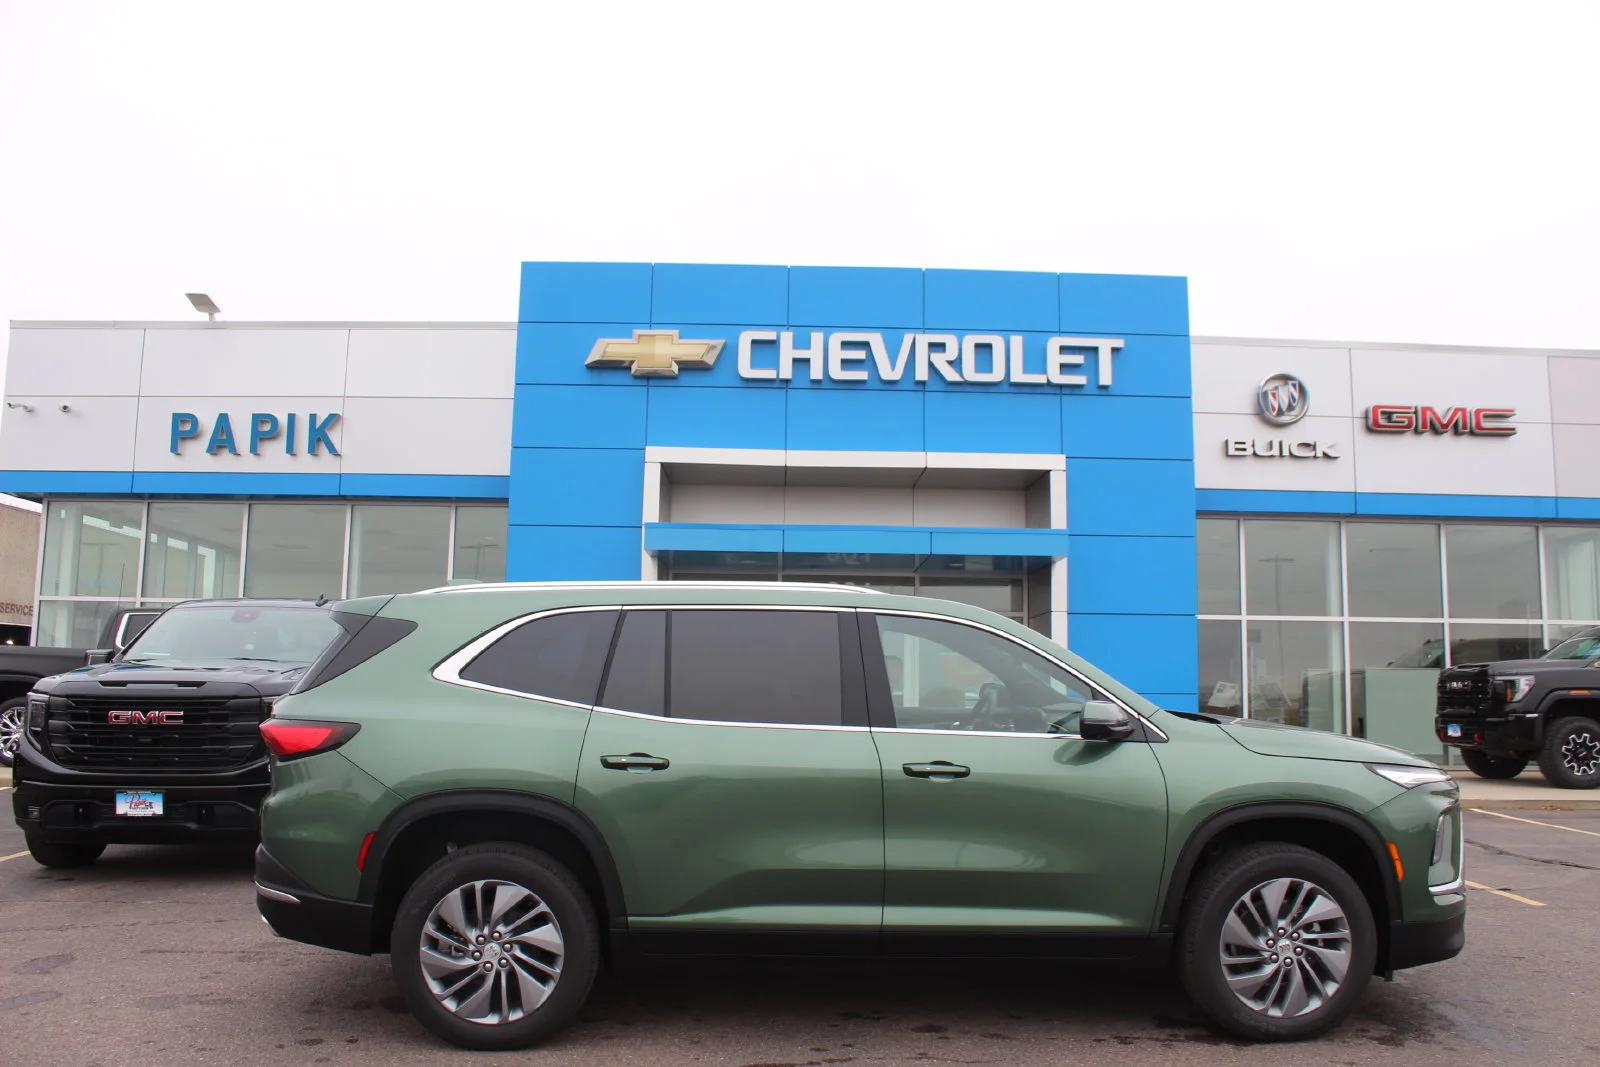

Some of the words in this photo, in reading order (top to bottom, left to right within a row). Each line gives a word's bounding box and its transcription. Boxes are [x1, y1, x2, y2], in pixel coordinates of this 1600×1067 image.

[737, 330, 1125, 386] CHEVROLET
[1365, 404, 1517, 435] GMC
[169, 412, 341, 456] PAPIK
[1225, 438, 1341, 459] BUICK
[0, 602, 33, 616] SERVICE
[108, 710, 184, 725] GMC
